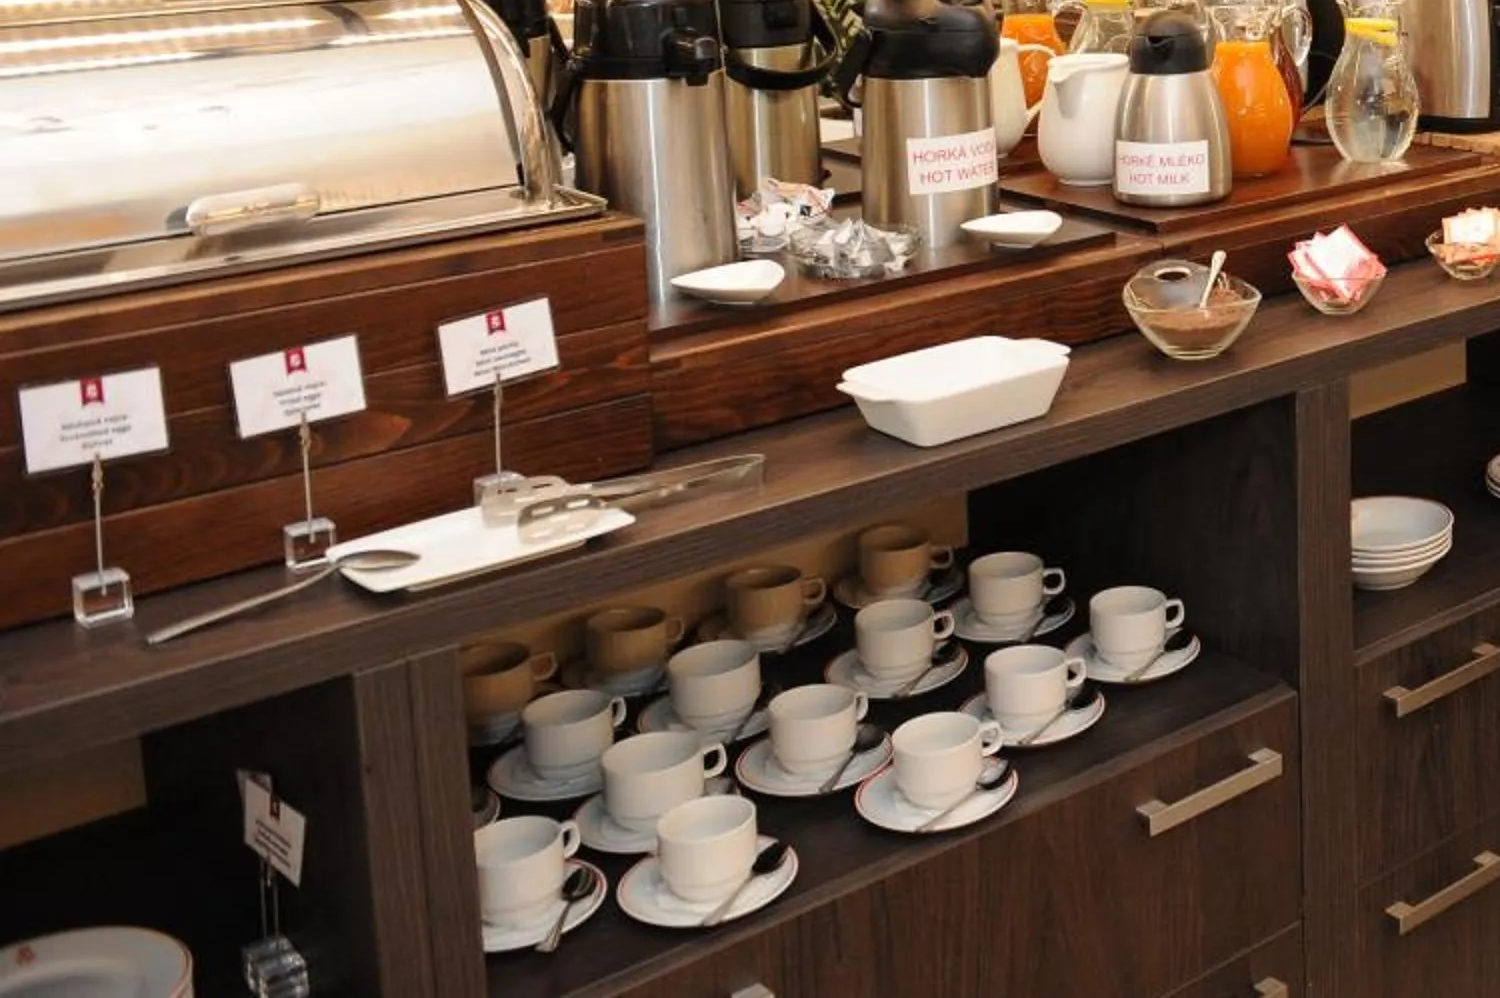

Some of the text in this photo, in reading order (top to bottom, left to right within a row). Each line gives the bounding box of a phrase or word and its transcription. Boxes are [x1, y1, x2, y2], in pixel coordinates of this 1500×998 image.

[919, 168, 953, 186] HOT
[1129, 172, 1191, 185] HOT MILK
